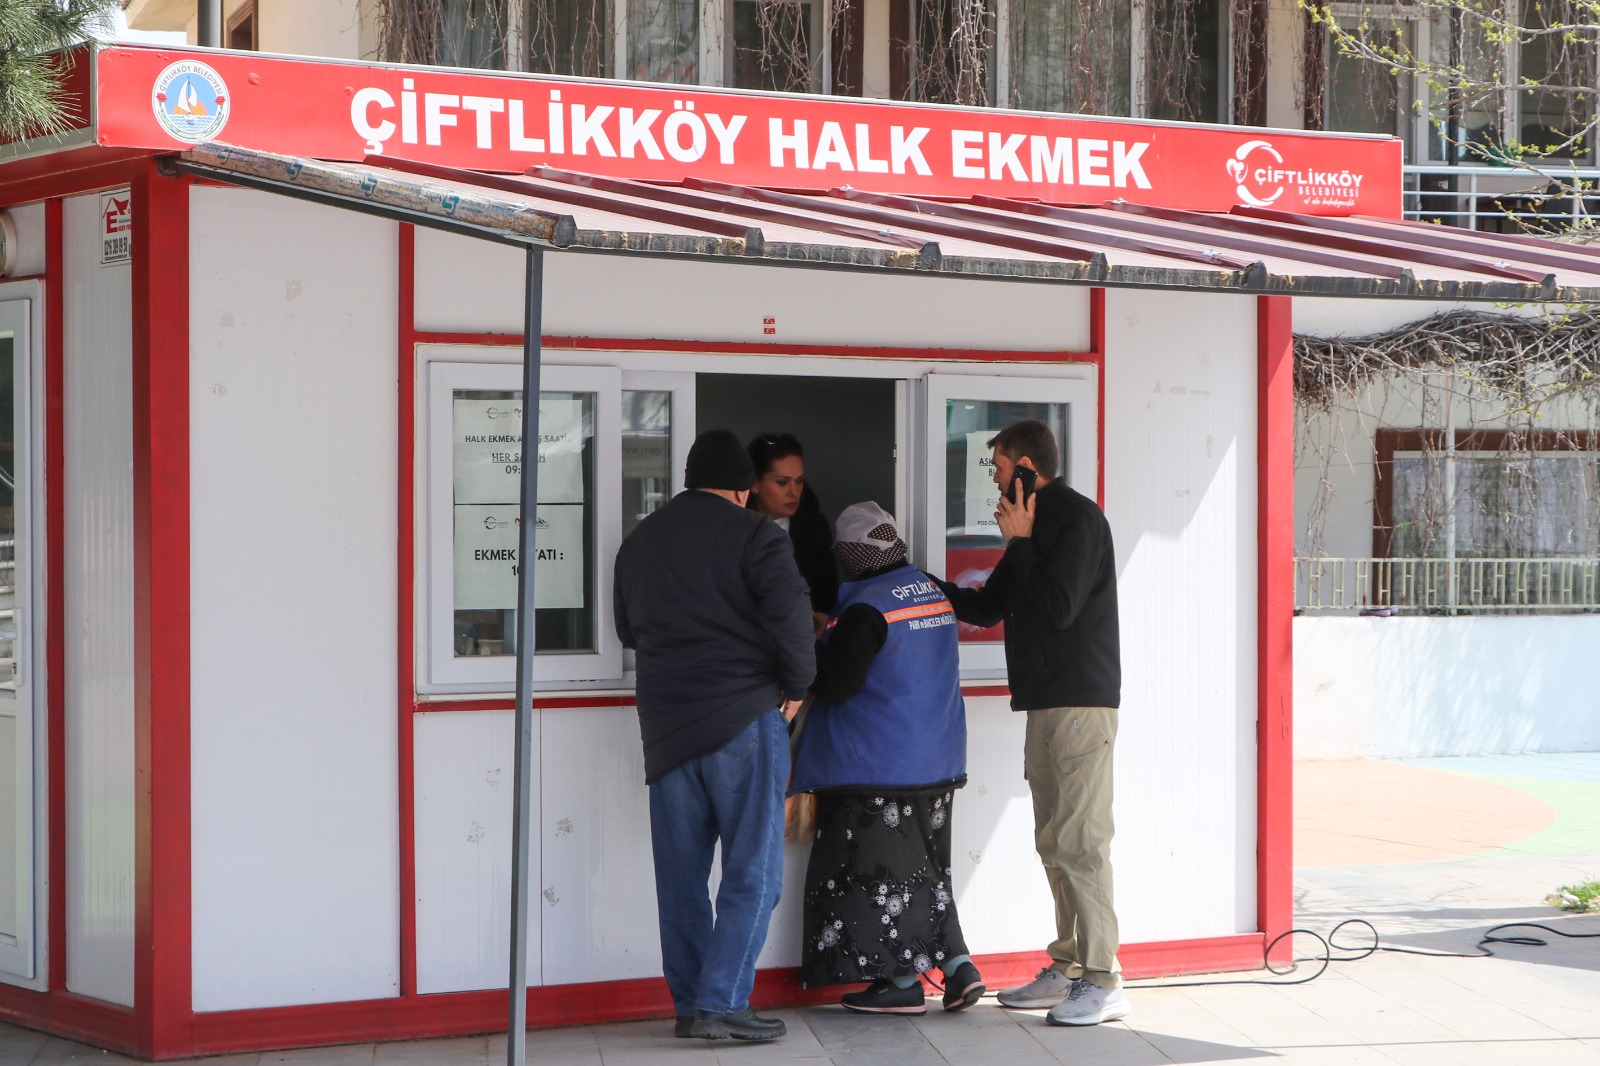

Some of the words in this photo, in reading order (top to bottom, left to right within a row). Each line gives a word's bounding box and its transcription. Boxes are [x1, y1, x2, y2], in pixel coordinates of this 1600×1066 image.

[350, 78, 748, 164] ÇİFTLİKKÖY
[768, 117, 933, 176] HALK
[950, 129, 1152, 189] EKMEK
[1254, 166, 1363, 187] ÇİFTLİKKÖY
[1298, 186, 1359, 198] BELEDİYESİ
[465, 435, 487, 443] HALK
[488, 435, 516, 443] EKMEK
[492, 453, 511, 462] HER
[979, 457, 994, 466] ASK
[505, 465, 521, 474] 09:
[474, 549, 516, 560] EKMEK
